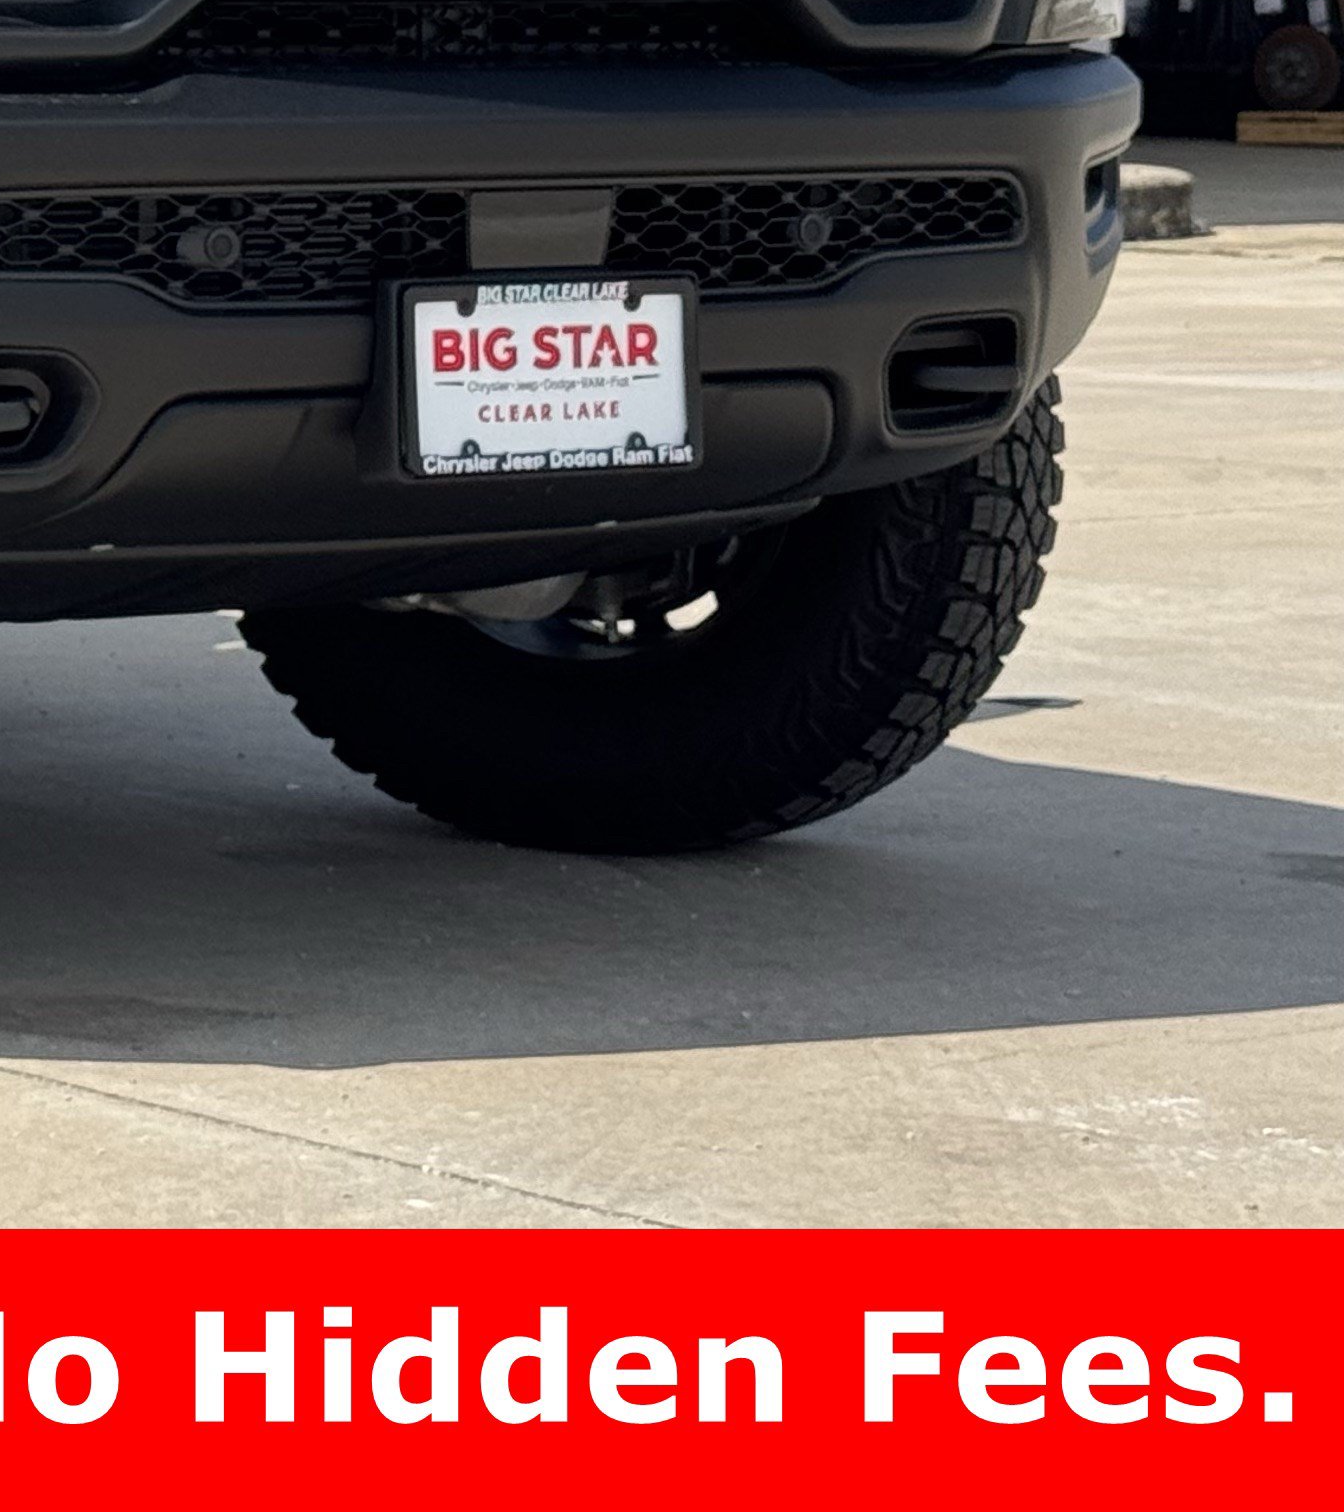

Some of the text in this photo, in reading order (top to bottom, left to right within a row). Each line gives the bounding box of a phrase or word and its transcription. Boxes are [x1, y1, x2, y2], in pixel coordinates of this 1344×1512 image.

[477, 280, 630, 305] BIG STAR CLEAR LAKE
[432, 323, 659, 373] BIG STAR
[478, 400, 621, 423] CLEAR LAKE
[423, 444, 694, 475] Chrysler Jeep Dodge Ram Fiat
